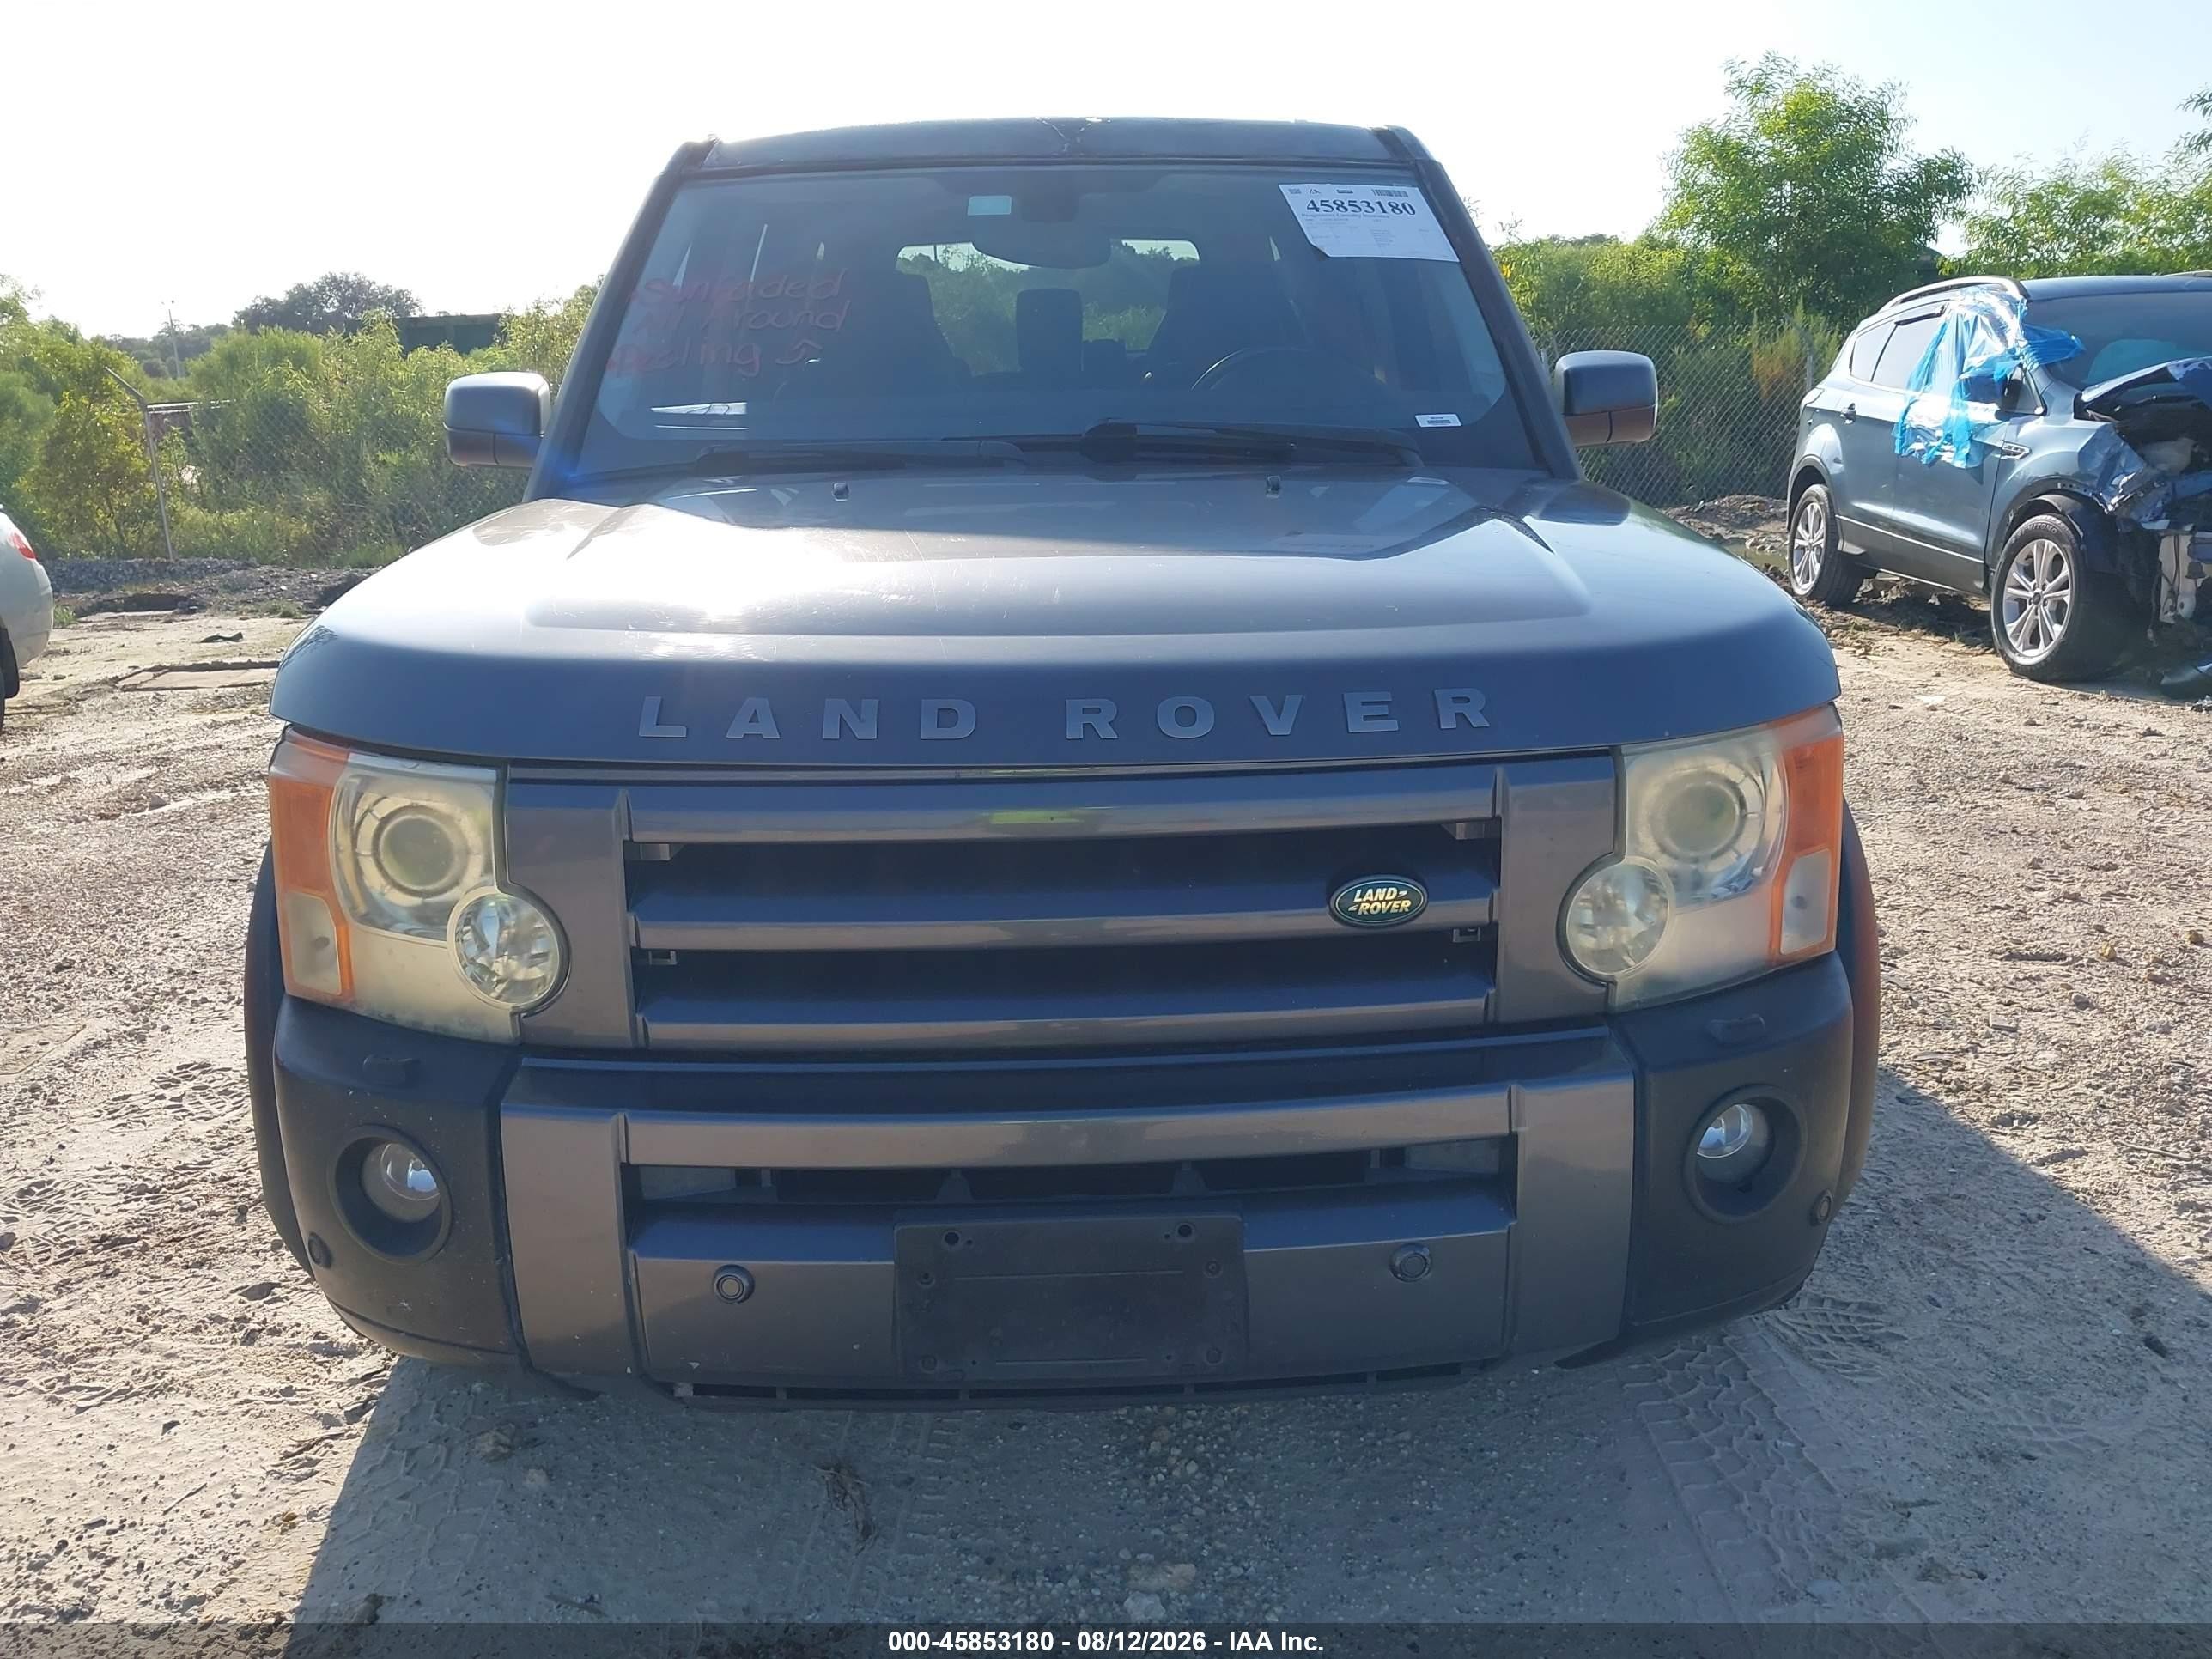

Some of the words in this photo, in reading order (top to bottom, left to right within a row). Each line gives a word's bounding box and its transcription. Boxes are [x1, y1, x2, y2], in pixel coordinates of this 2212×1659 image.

[1306, 199, 1416, 216] 45853180
[638, 696, 977, 739] LAND
[1065, 688, 1491, 739] ROVER
[1353, 887, 1398, 902] LAND
[1358, 900, 1412, 915] ROVER
